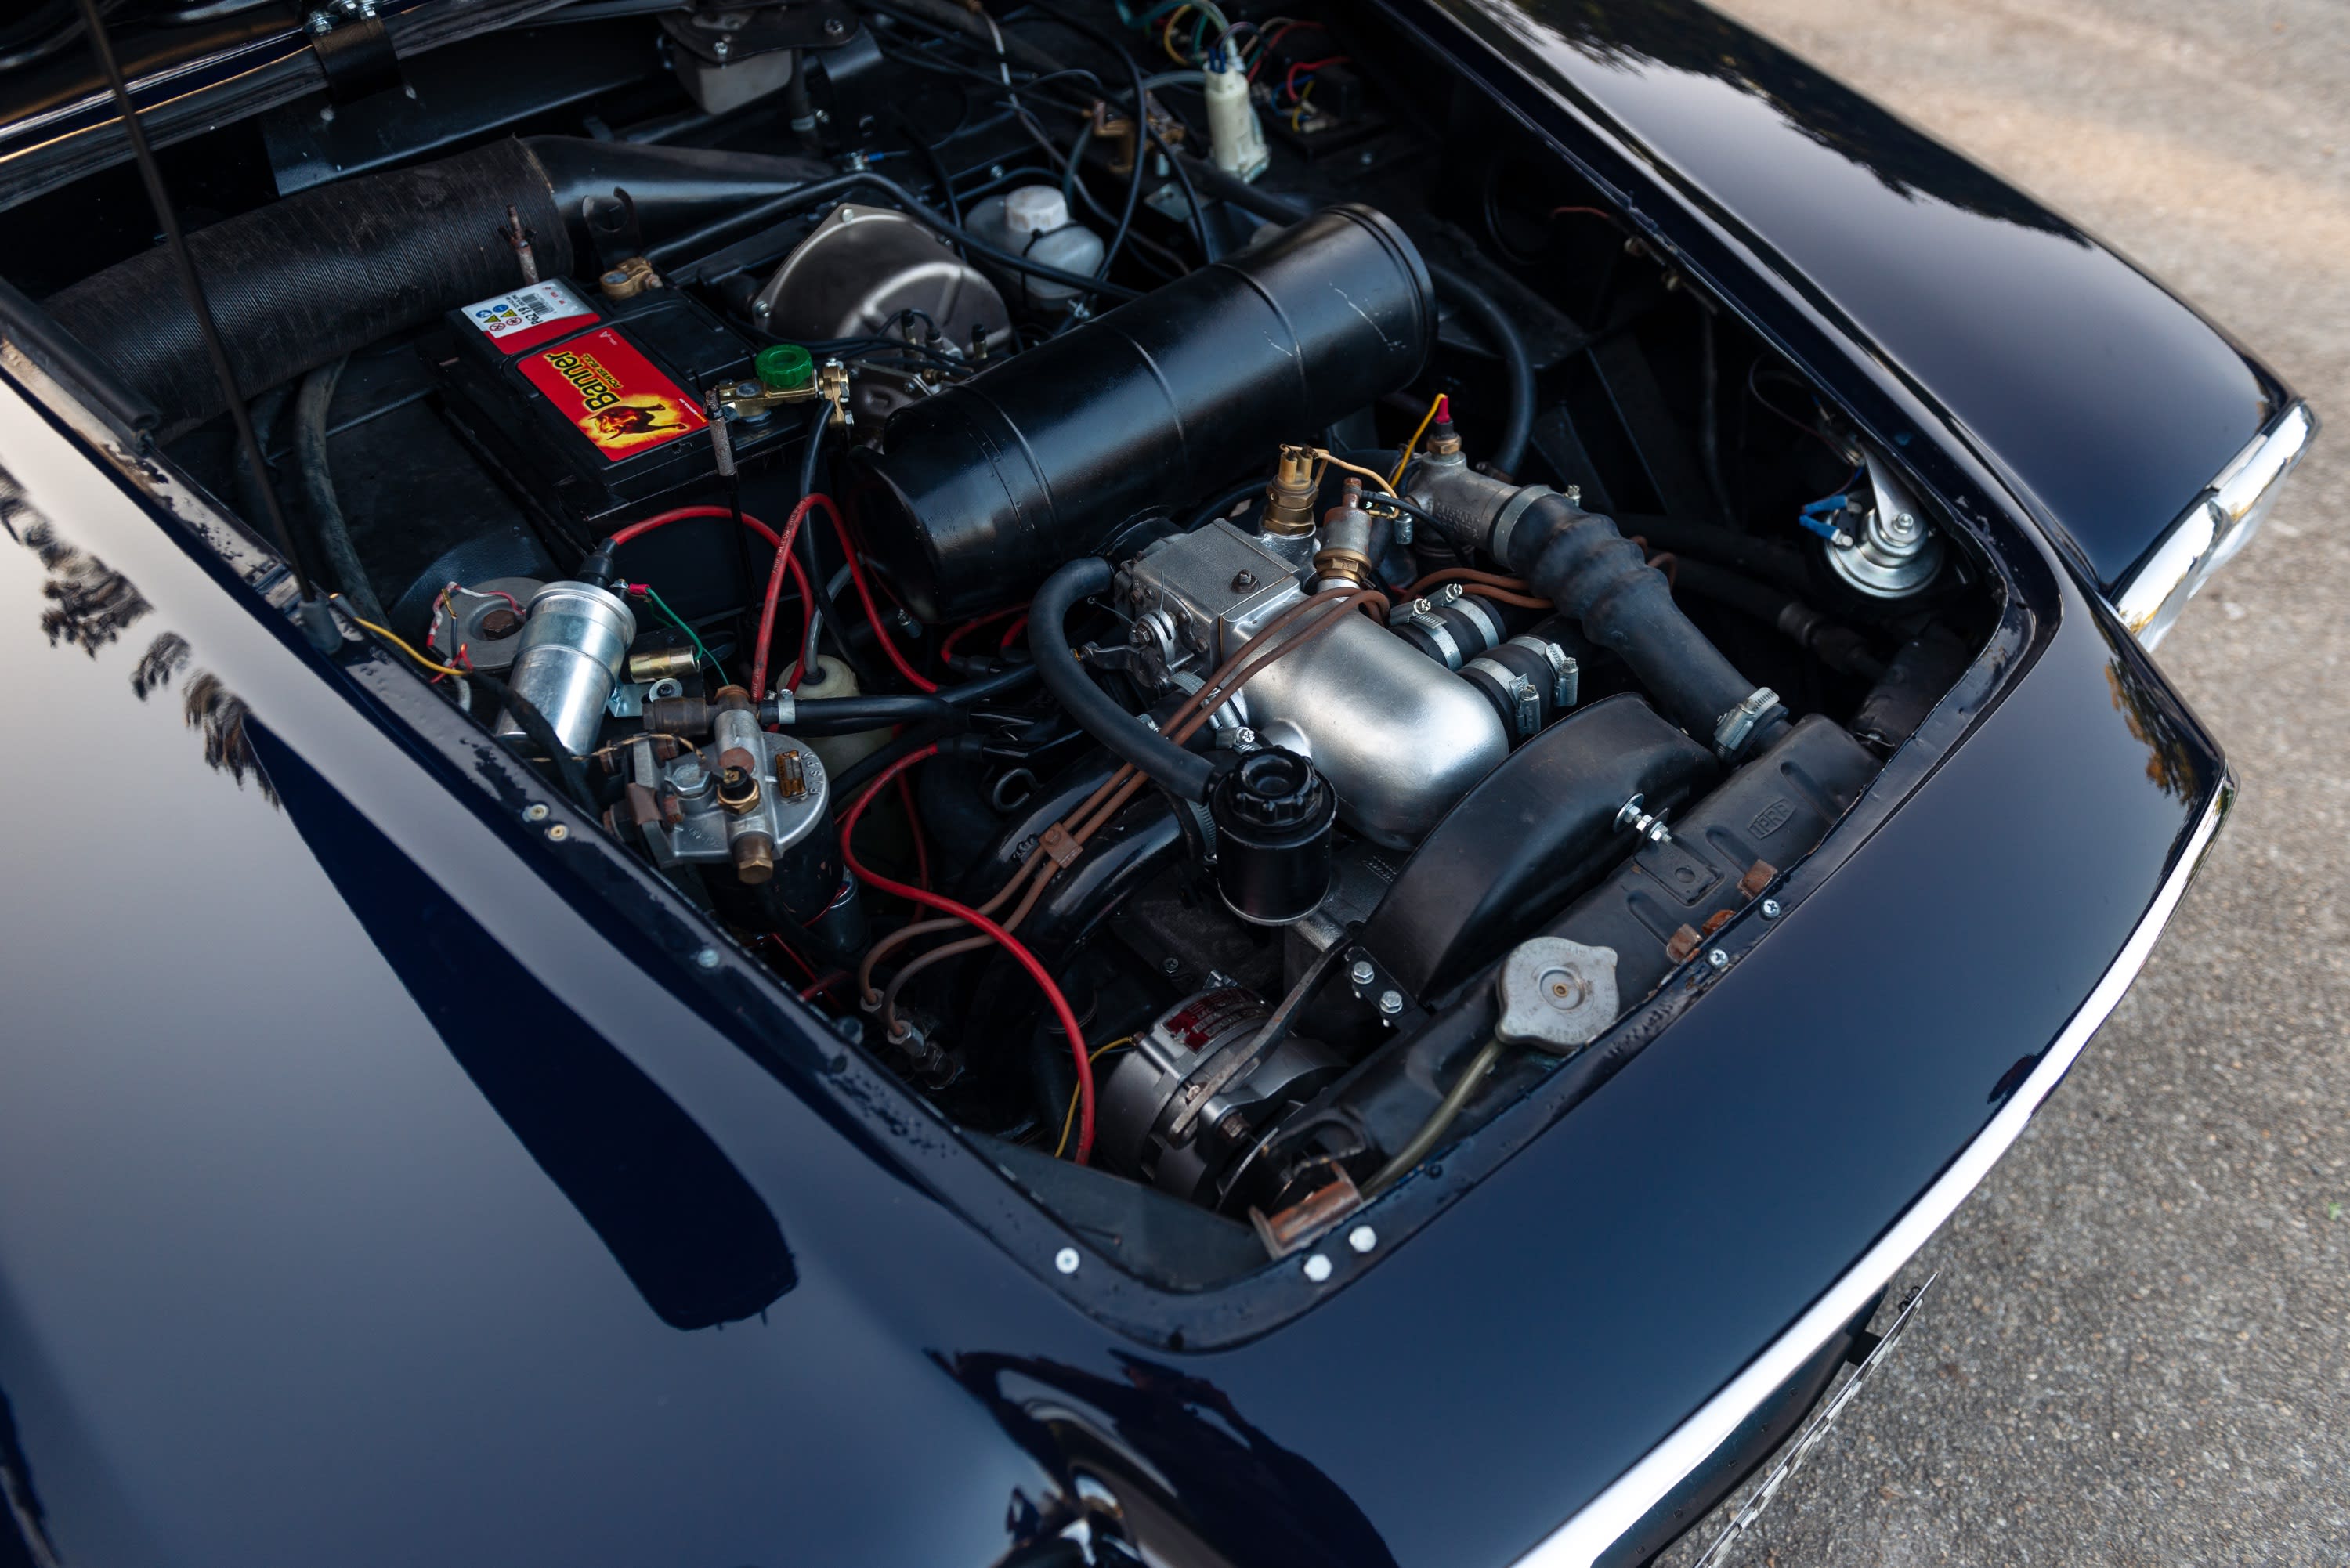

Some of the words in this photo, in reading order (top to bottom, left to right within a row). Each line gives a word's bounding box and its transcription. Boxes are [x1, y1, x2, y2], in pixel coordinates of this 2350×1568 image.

[526, 313, 543, 324] P62
[583, 354, 599, 367] BULL
[544, 351, 621, 412] Banner
[597, 368, 621, 388] POWER
[802, 752, 823, 794] FISPA
